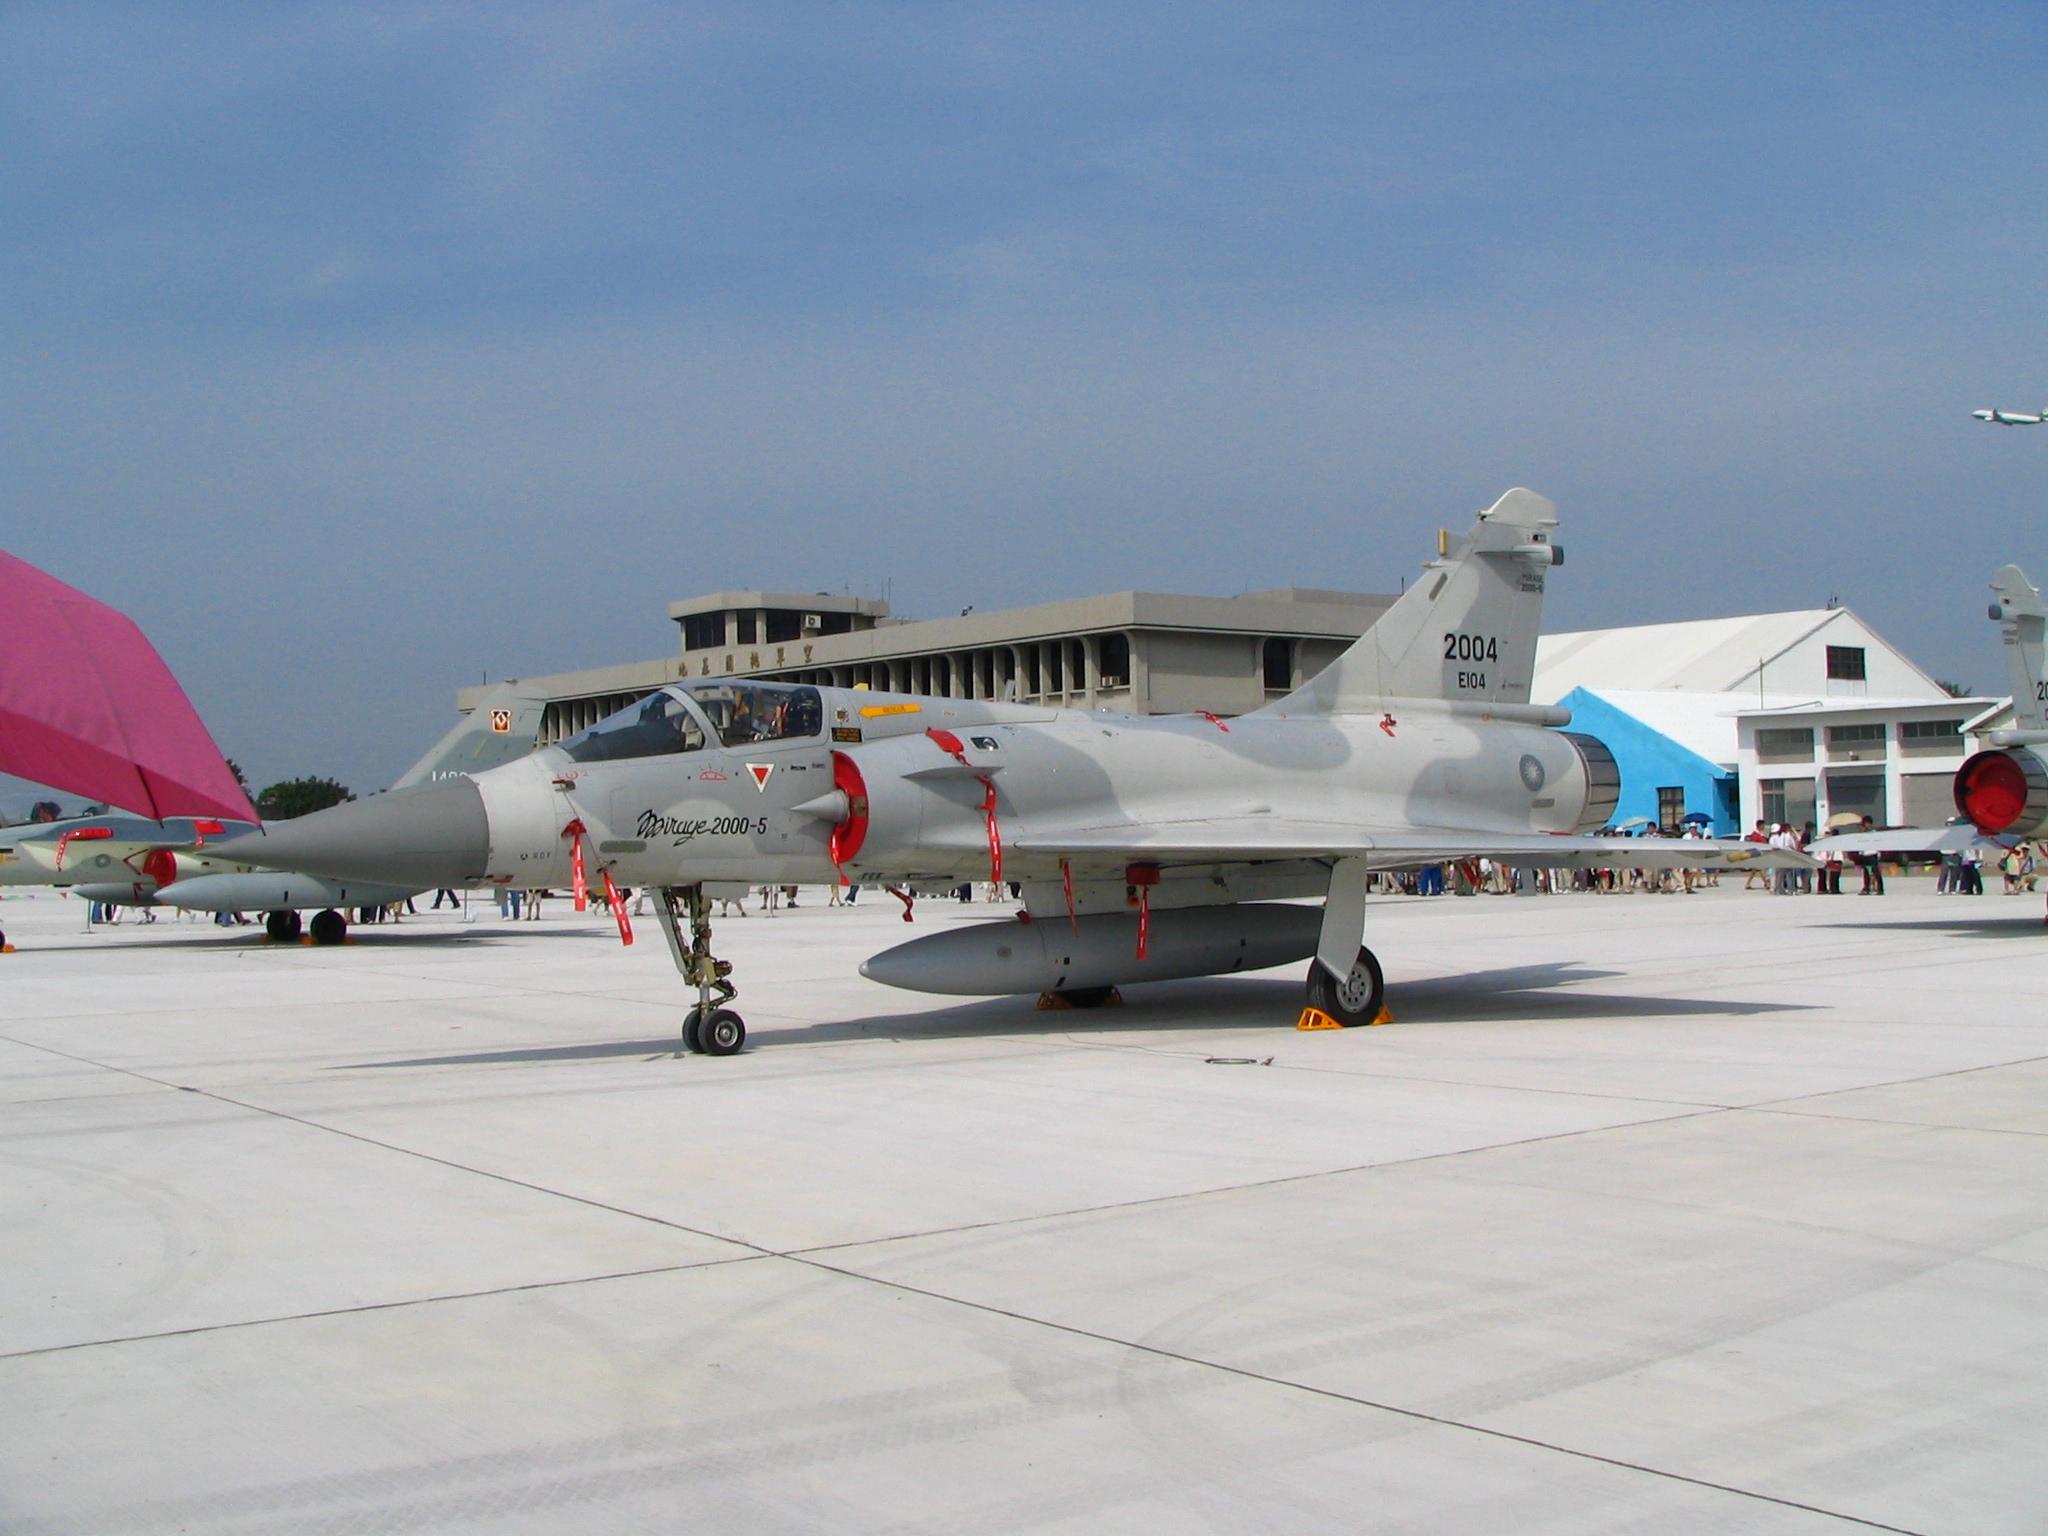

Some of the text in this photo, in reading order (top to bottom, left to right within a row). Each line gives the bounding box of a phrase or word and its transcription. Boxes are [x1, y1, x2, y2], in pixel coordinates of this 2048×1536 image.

[1444, 633, 1497, 663] 2004
[1458, 671, 1486, 690] E104
[636, 808, 768, 847] Mirage 2000-5
